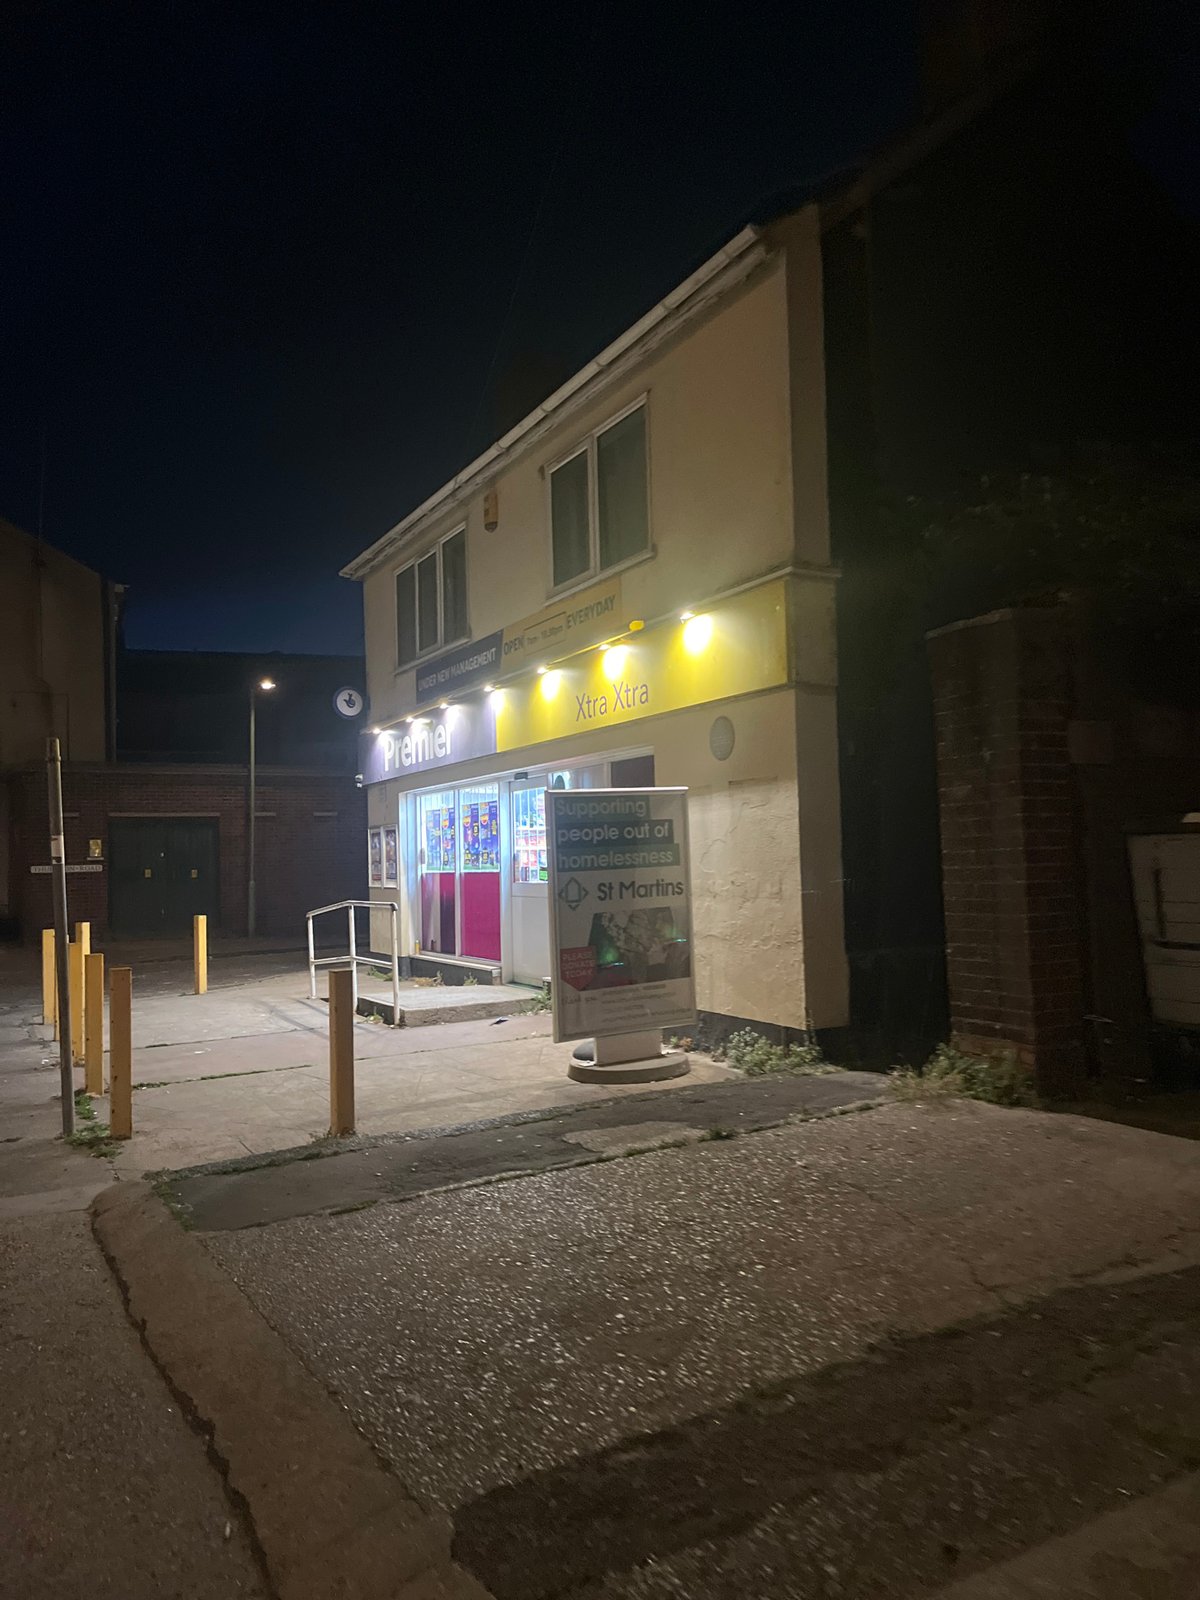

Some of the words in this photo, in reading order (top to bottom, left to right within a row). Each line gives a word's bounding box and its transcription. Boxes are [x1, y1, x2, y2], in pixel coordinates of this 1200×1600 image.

[503, 635, 524, 656] OPEN
[566, 595, 616, 629] EVERYDAY
[418, 673, 437, 691] UNDER
[438, 667, 450, 682] NEW
[450, 647, 496, 678] MANAGEMENT
[576, 693, 607, 722] Xtra
[613, 681, 649, 712] Xtra
[384, 722, 454, 772] Premier
[556, 799, 647, 818] Supporting
[558, 824, 619, 843] people
[623, 823, 650, 839] out
[654, 822, 669, 838] of
[559, 850, 673, 868] homelessness
[597, 881, 615, 901] St
[619, 879, 684, 900] Martins
